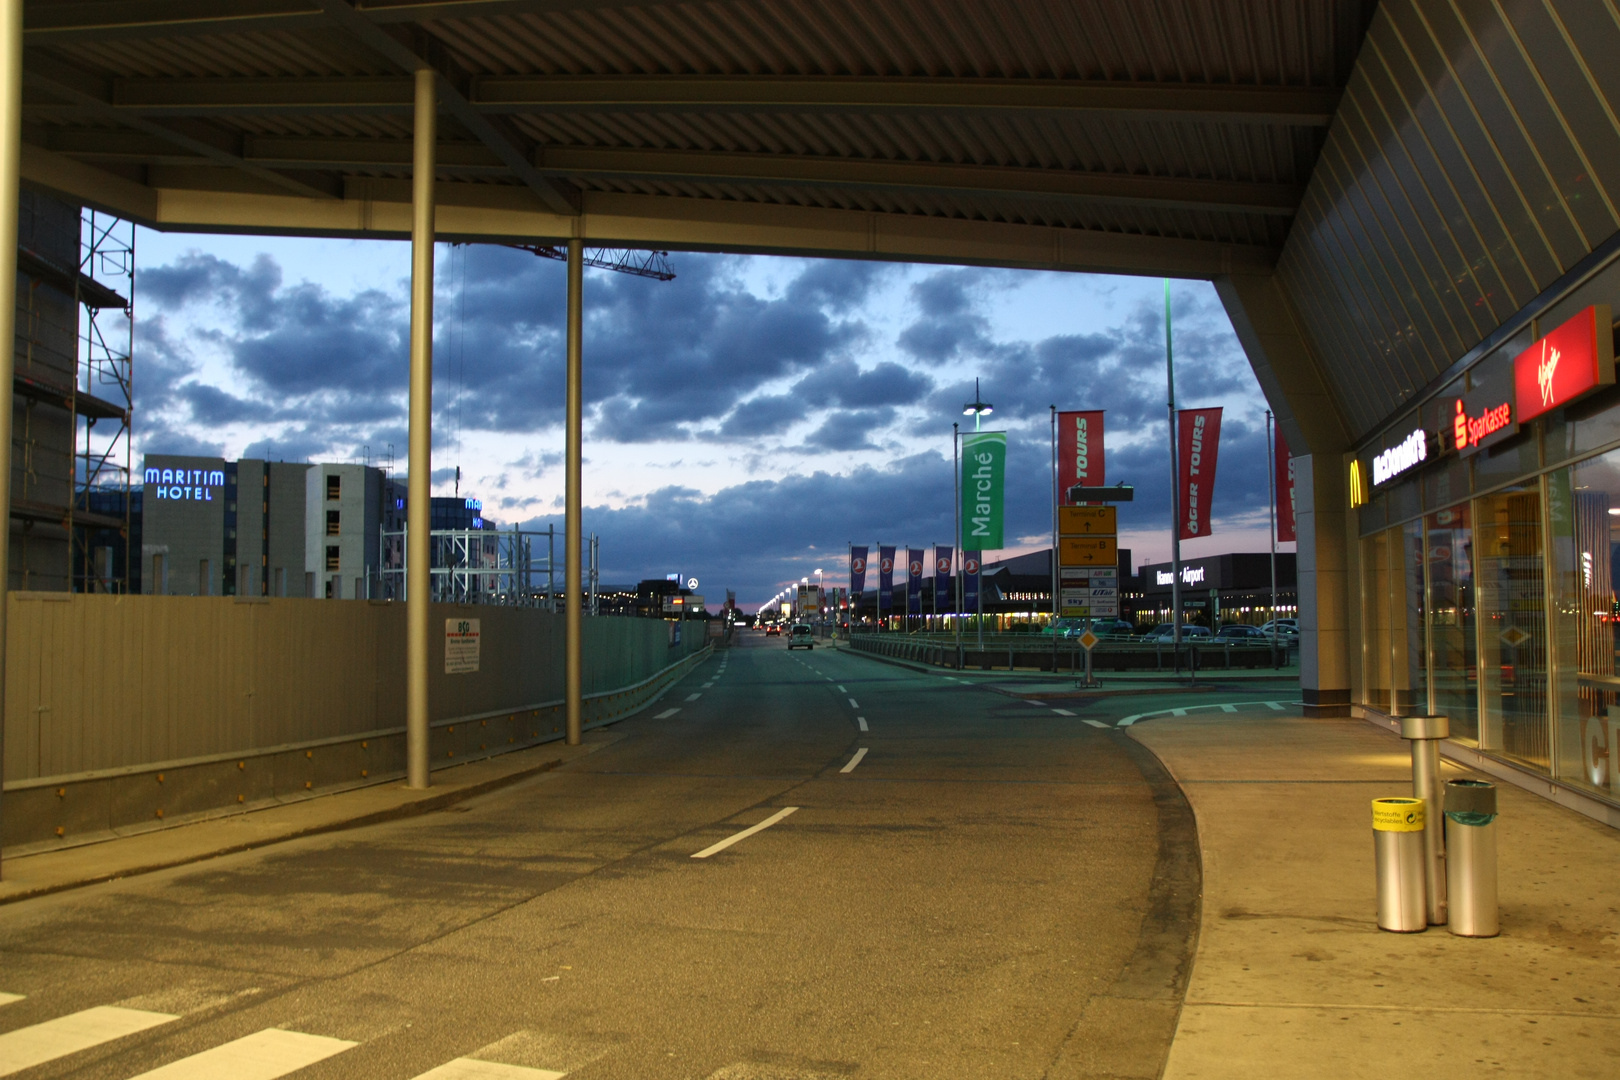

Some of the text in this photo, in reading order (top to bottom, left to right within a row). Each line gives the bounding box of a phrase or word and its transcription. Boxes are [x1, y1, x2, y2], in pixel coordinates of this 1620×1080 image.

[1538, 338, 1561, 407] Virgin
[1467, 402, 1511, 448] Sparkasse
[1076, 417, 1088, 479] TOURS
[145, 468, 224, 486] MARITIM
[1188, 415, 1205, 534] ÖGER TOURS
[157, 486, 212, 501] HOTEL
[971, 452, 993, 536] Marché
[1099, 509, 1105, 518] C
[1099, 541, 1106, 549] B
[1183, 566, 1204, 586] Airport
